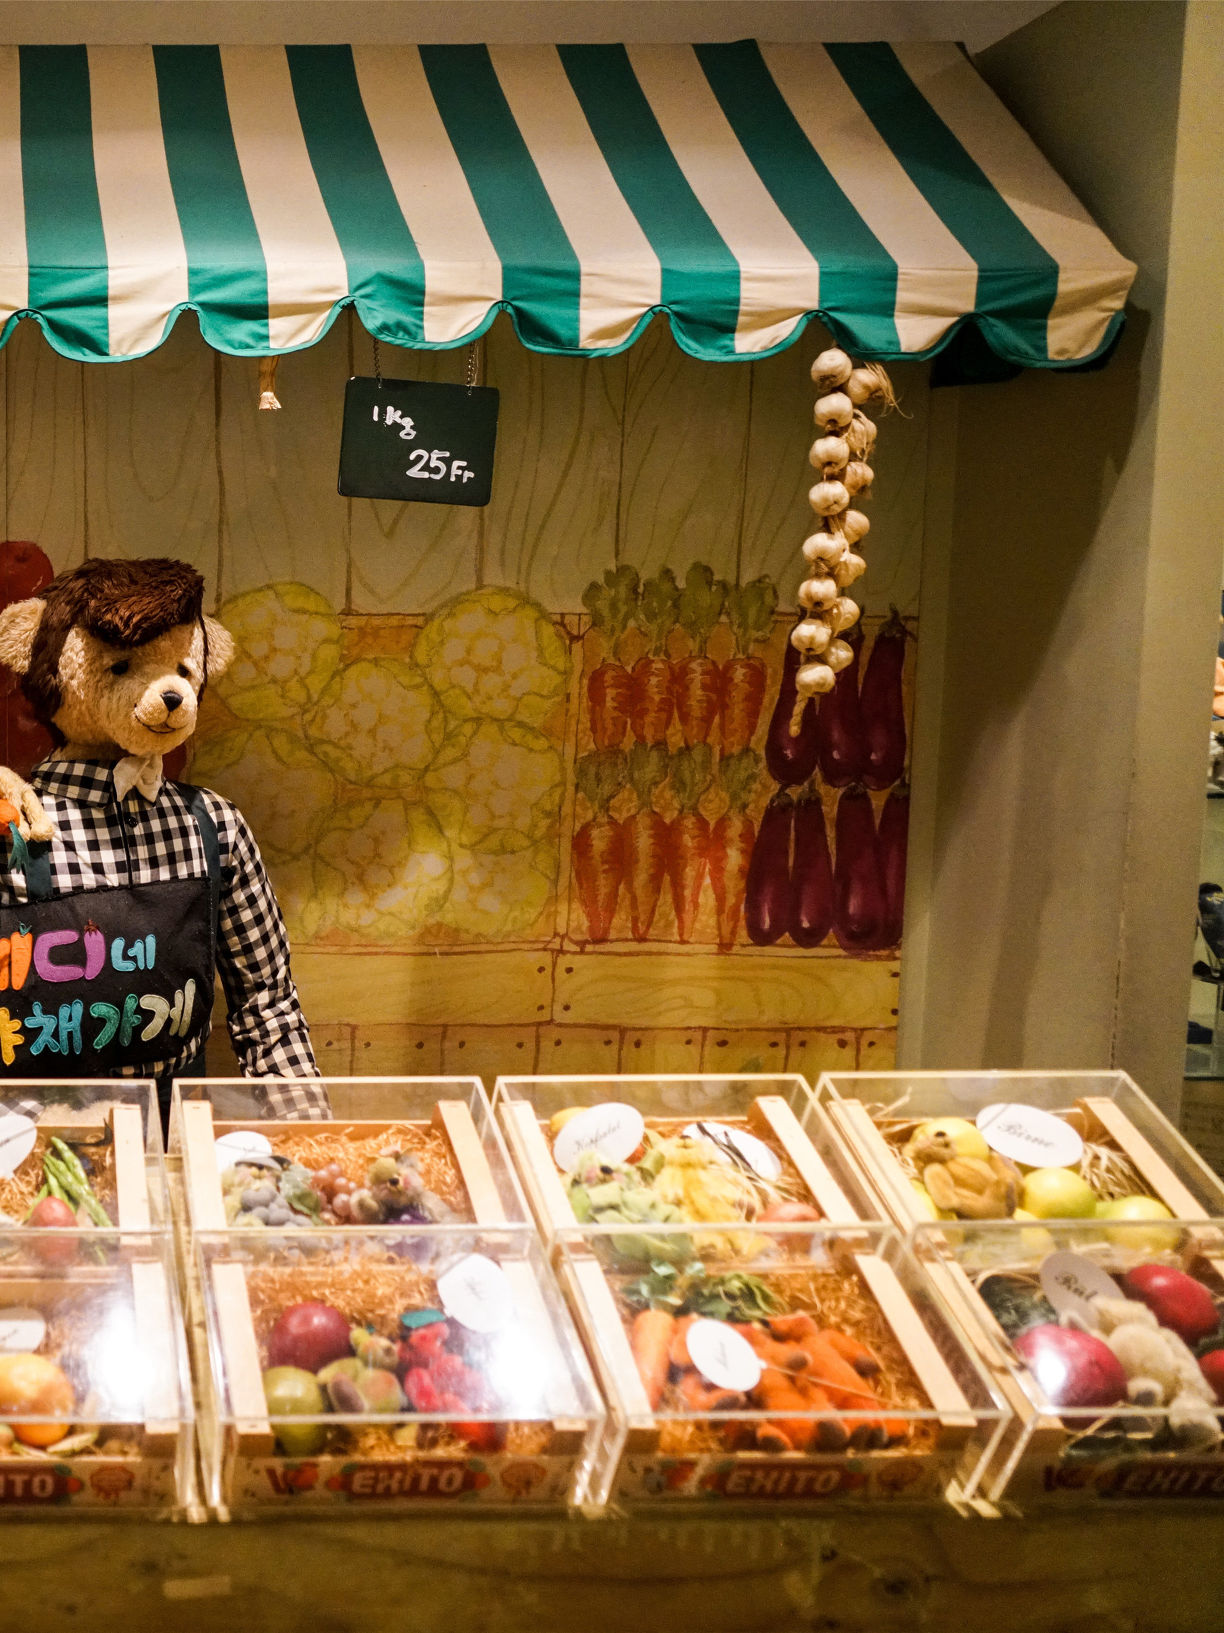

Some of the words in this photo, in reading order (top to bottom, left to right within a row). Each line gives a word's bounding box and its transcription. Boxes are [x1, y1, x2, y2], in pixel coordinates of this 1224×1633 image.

[405, 448, 475, 484] 25Fr
[351, 1466, 465, 1494] EXITO
[726, 1468, 841, 1494] EXITO
